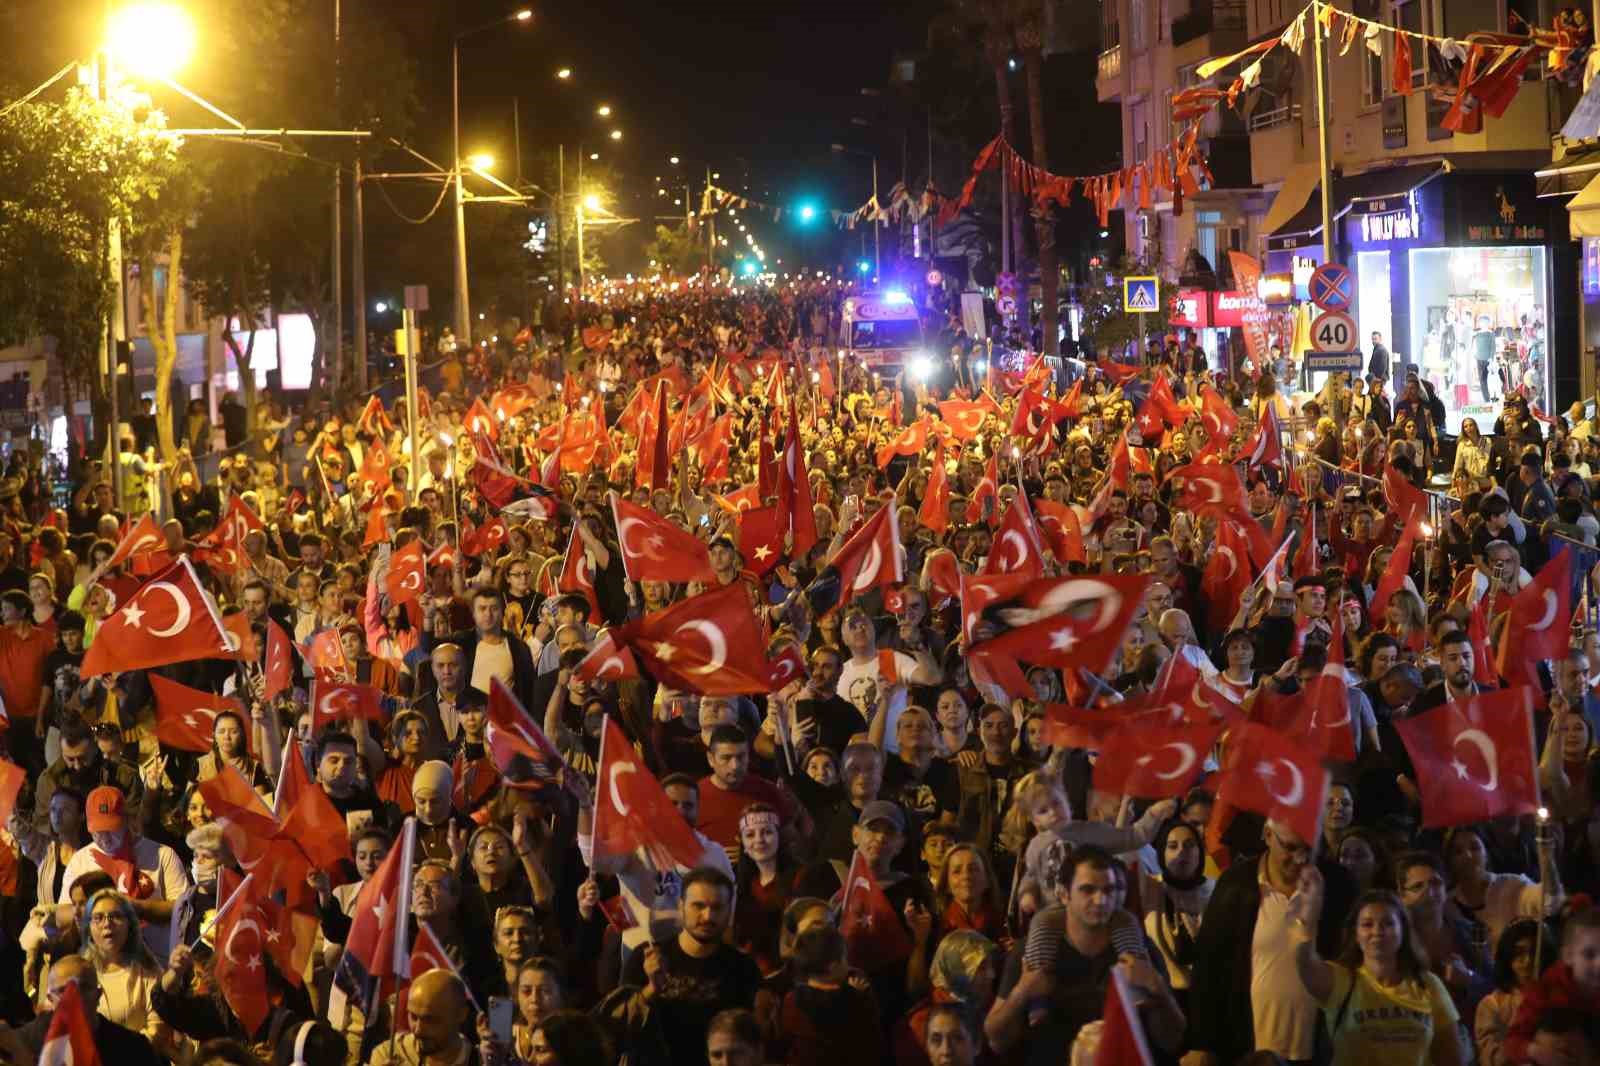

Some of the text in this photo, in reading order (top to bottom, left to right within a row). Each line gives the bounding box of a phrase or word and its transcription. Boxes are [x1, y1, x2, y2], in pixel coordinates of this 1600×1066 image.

[1370, 215, 1393, 241] WILLY
[1468, 224, 1511, 240] WILLY
[1318, 323, 1348, 345] 40
